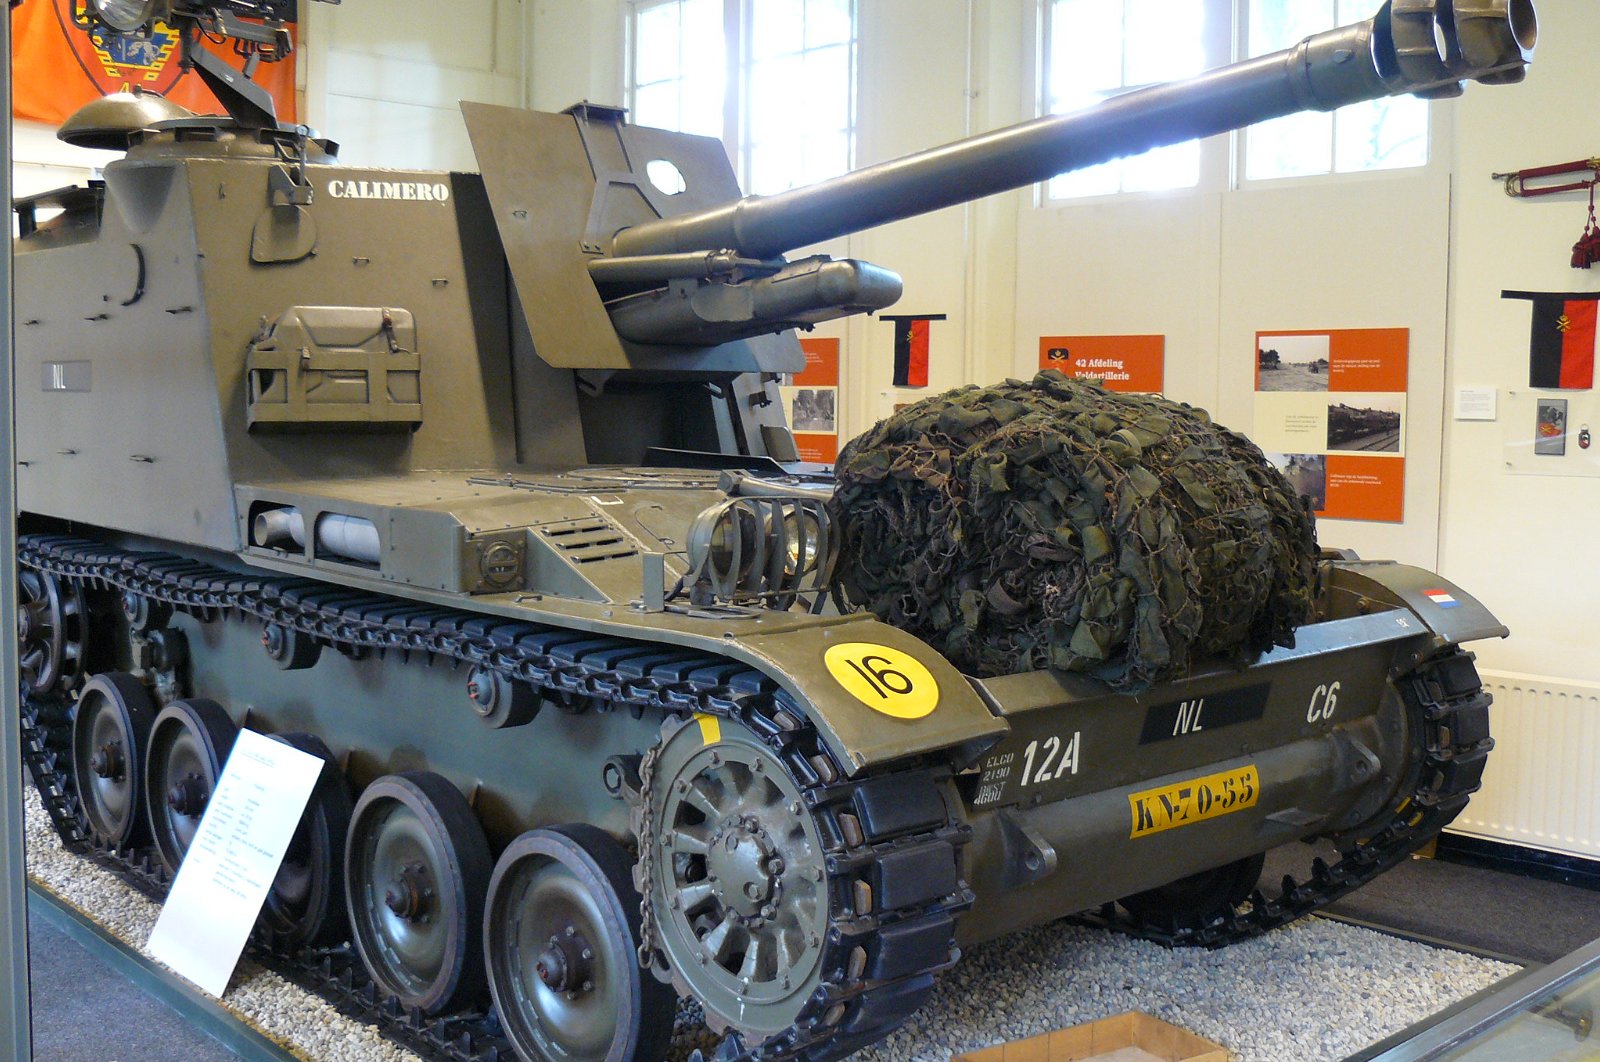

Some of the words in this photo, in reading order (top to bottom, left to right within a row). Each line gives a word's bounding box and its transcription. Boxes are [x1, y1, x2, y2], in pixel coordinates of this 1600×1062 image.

[328, 180, 449, 201] CALIMERO
[53, 364, 66, 389] NL
[1075, 359, 1086, 368] 42
[1088, 358, 1124, 370] Afdeling
[844, 655, 914, 699] 16
[1172, 698, 1204, 736] NL
[1306, 681, 1341, 723] C6
[982, 766, 1011, 782] 2190
[1020, 731, 1081, 787] 12A
[1136, 773, 1253, 832] KN-70-55
